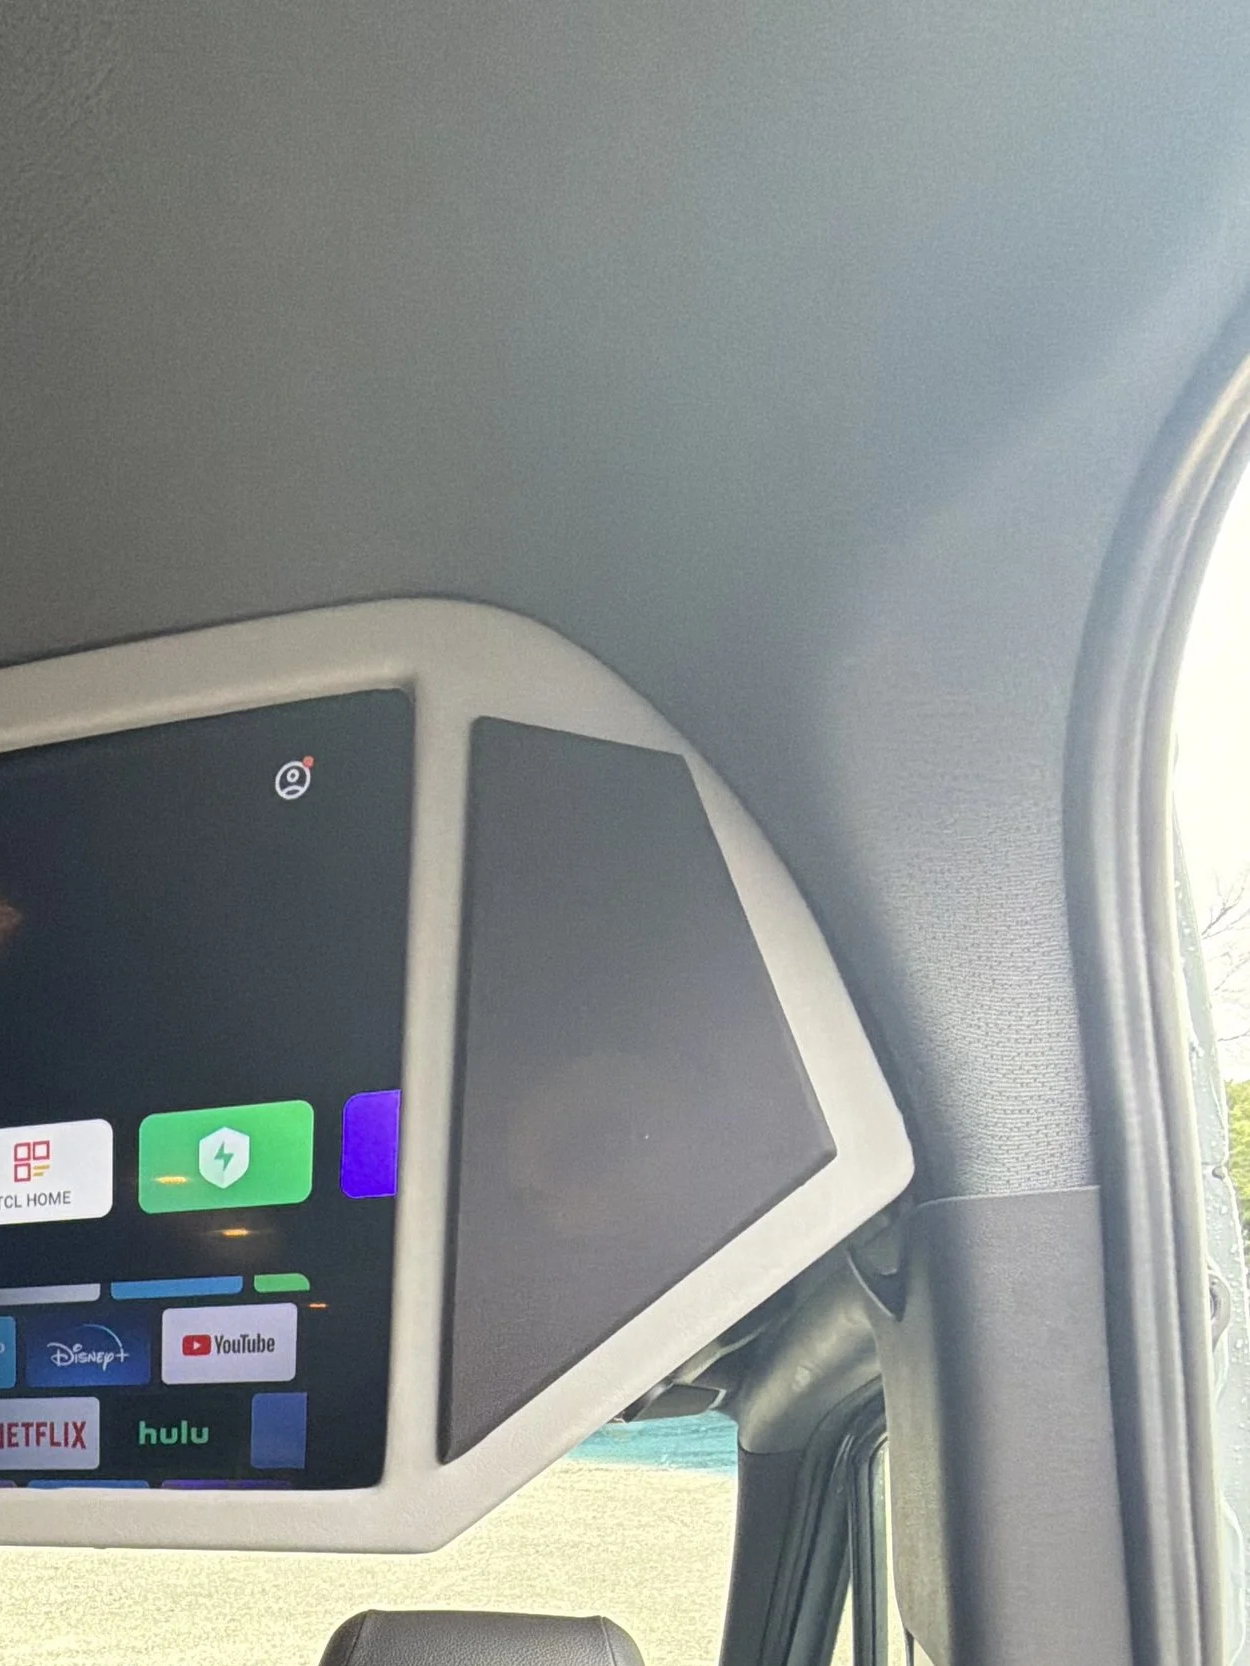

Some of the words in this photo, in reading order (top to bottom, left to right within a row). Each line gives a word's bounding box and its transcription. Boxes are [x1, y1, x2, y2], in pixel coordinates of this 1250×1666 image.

[26, 1190, 72, 1208] HOME
[213, 1333, 276, 1355] YouTube
[137, 1419, 210, 1445] hulu
